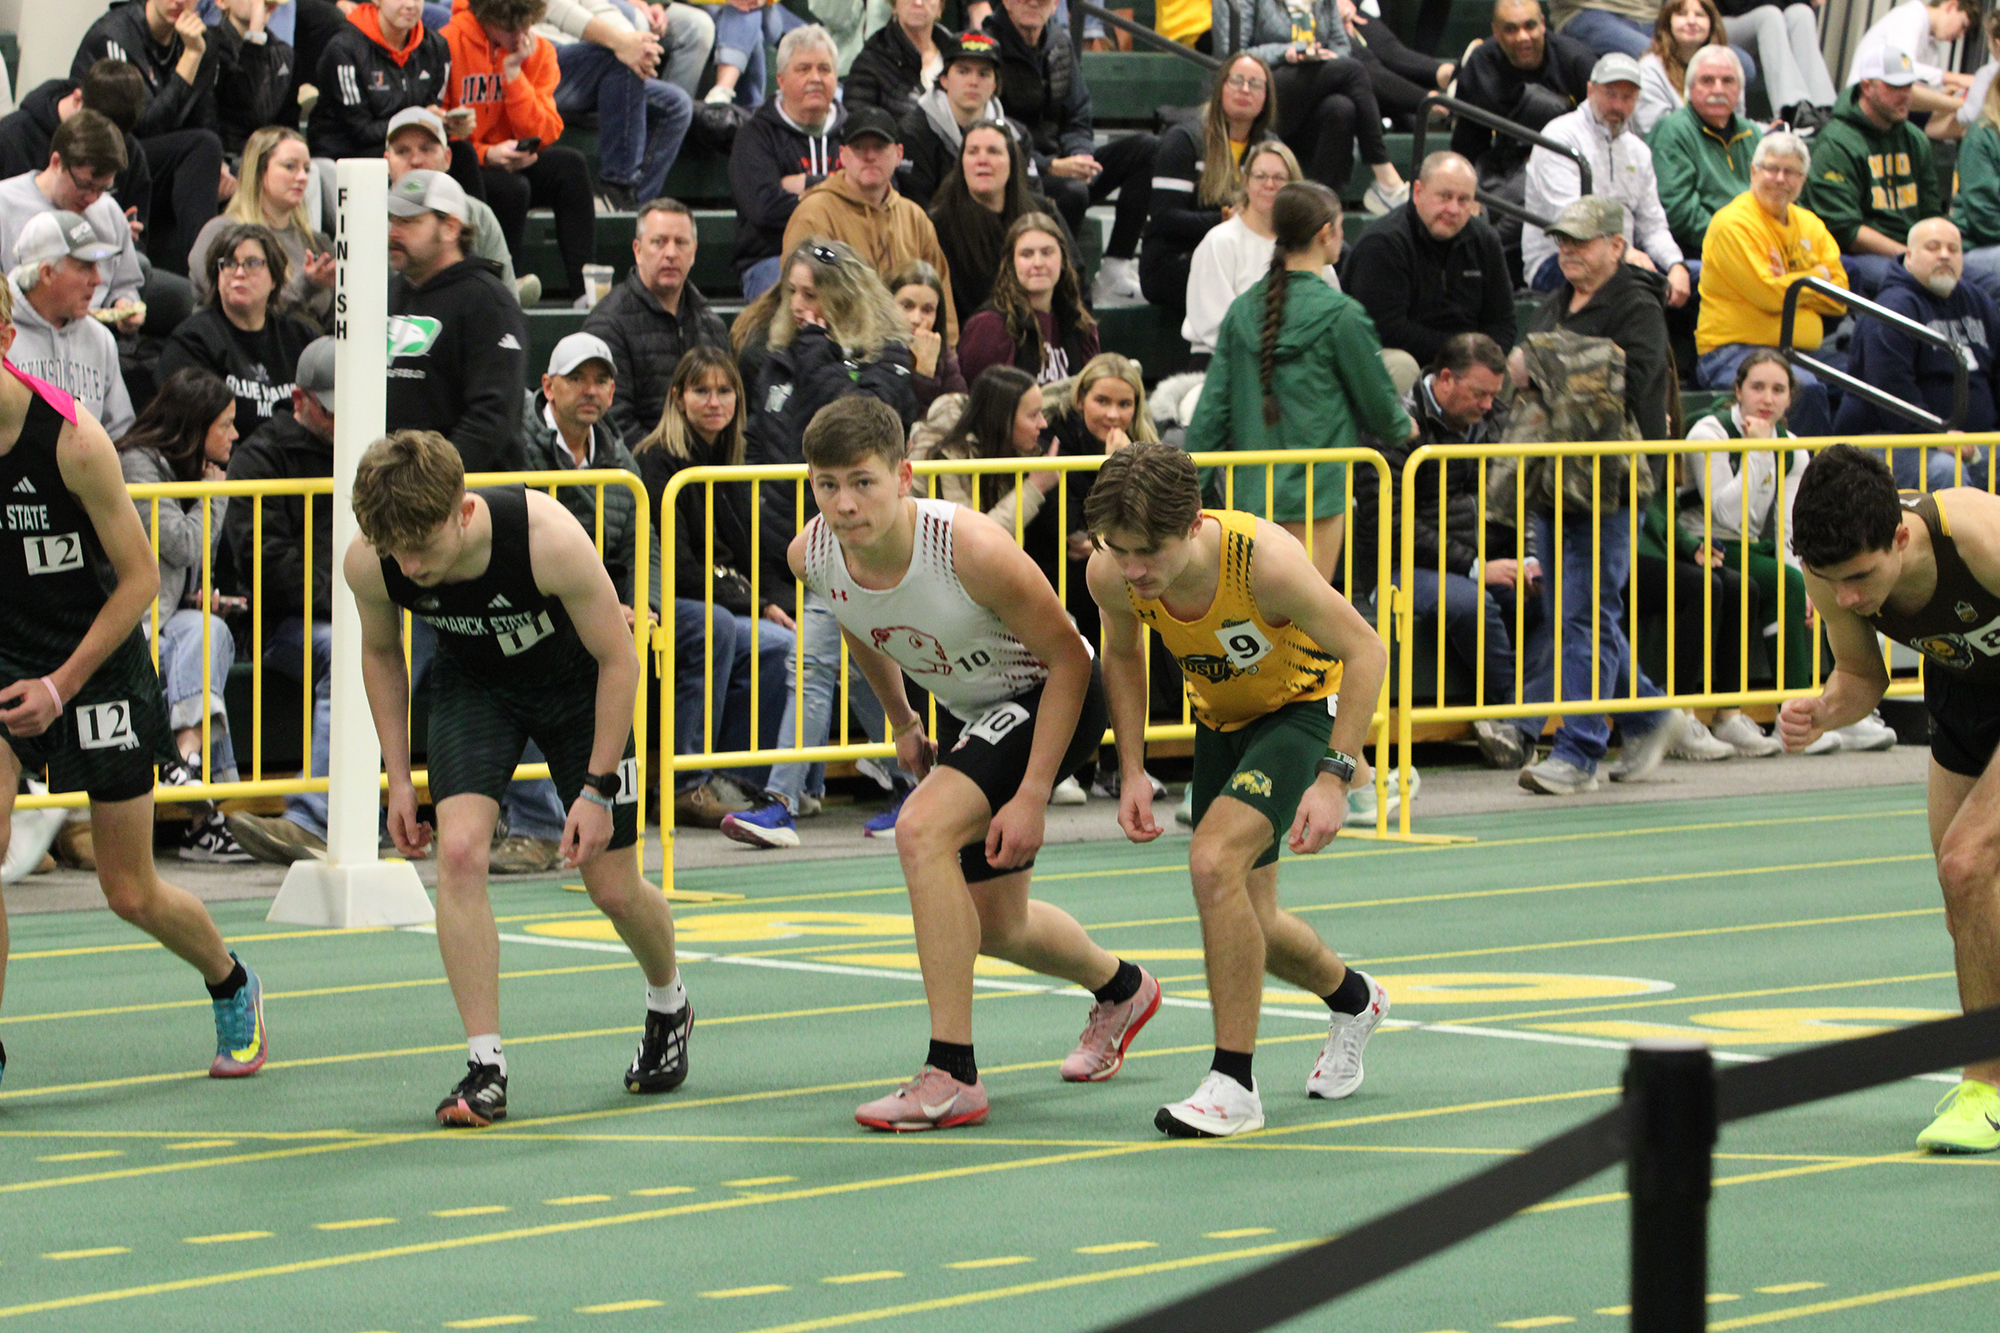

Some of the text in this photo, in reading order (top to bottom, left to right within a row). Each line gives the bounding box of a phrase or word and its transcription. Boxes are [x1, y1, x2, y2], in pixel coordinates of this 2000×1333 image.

[336, 178, 350, 340] FINISH
[6, 504, 50, 531] STATE
[33, 535, 79, 568] 12
[1229, 634, 1261, 659] 9
[954, 649, 991, 673] 10
[86, 703, 128, 741] 12
[981, 706, 1017, 732] 10
